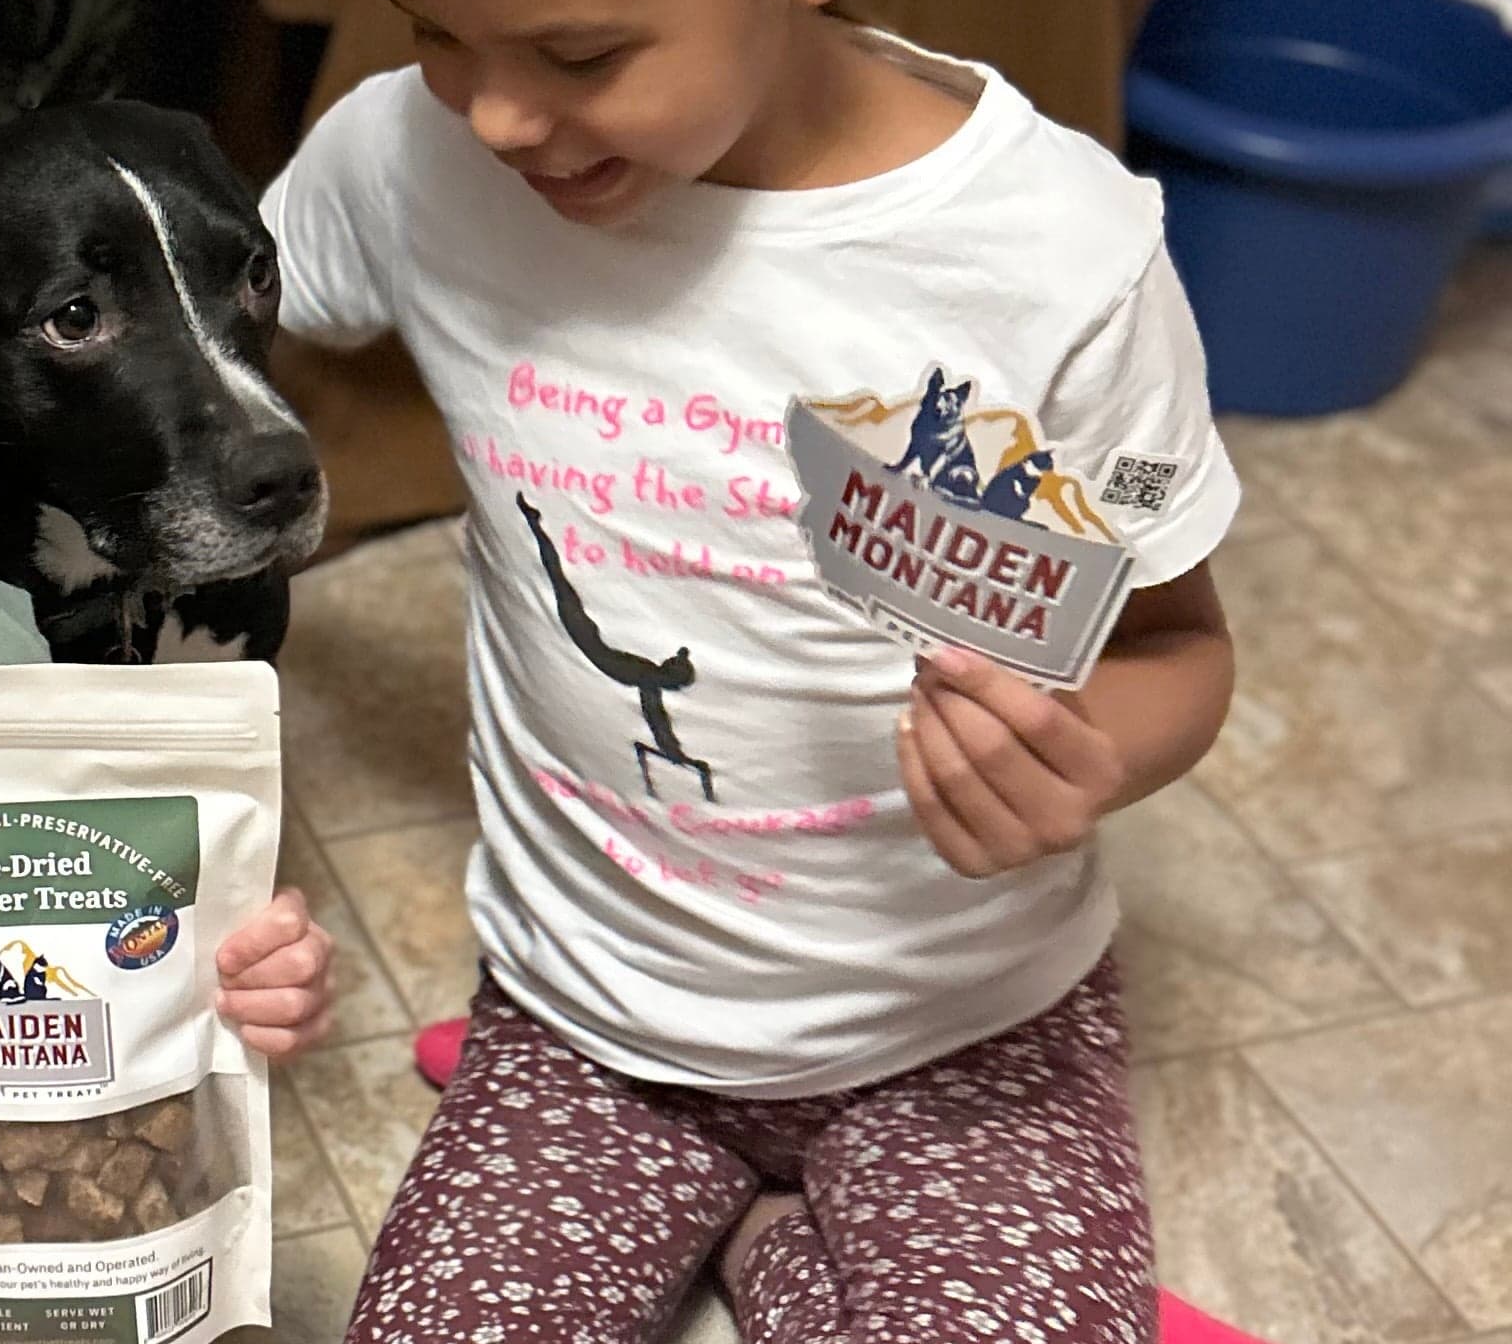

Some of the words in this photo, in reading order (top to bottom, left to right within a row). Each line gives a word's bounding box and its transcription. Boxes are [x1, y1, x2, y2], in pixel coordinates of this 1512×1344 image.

[507, 361, 629, 441] Being
[642, 397, 666, 426] a
[684, 393, 785, 454] Gym
[485, 436, 617, 515] having
[633, 458, 707, 511] the
[841, 468, 1074, 602] MAIDEN
[563, 523, 605, 564] to
[621, 537, 713, 578] hold
[828, 511, 1050, 643] MONTANA
[34, 887, 128, 912] Treats
[110, 908, 143, 938] MADE
[148, 905, 162, 916] IN
[140, 950, 165, 966] USA
[13, 1090, 38, 1099] PET
[67, 1262, 91, 1273] and
[95, 1250, 159, 1274] Operated.
[20, 1279, 47, 1291] pet's
[50, 1277, 89, 1290] healthy
[93, 1277, 113, 1288] and
[116, 1272, 148, 1286] happy
[150, 1266, 169, 1279] way
[45, 1307, 84, 1318] SERVE
[88, 1306, 115, 1318] WET
